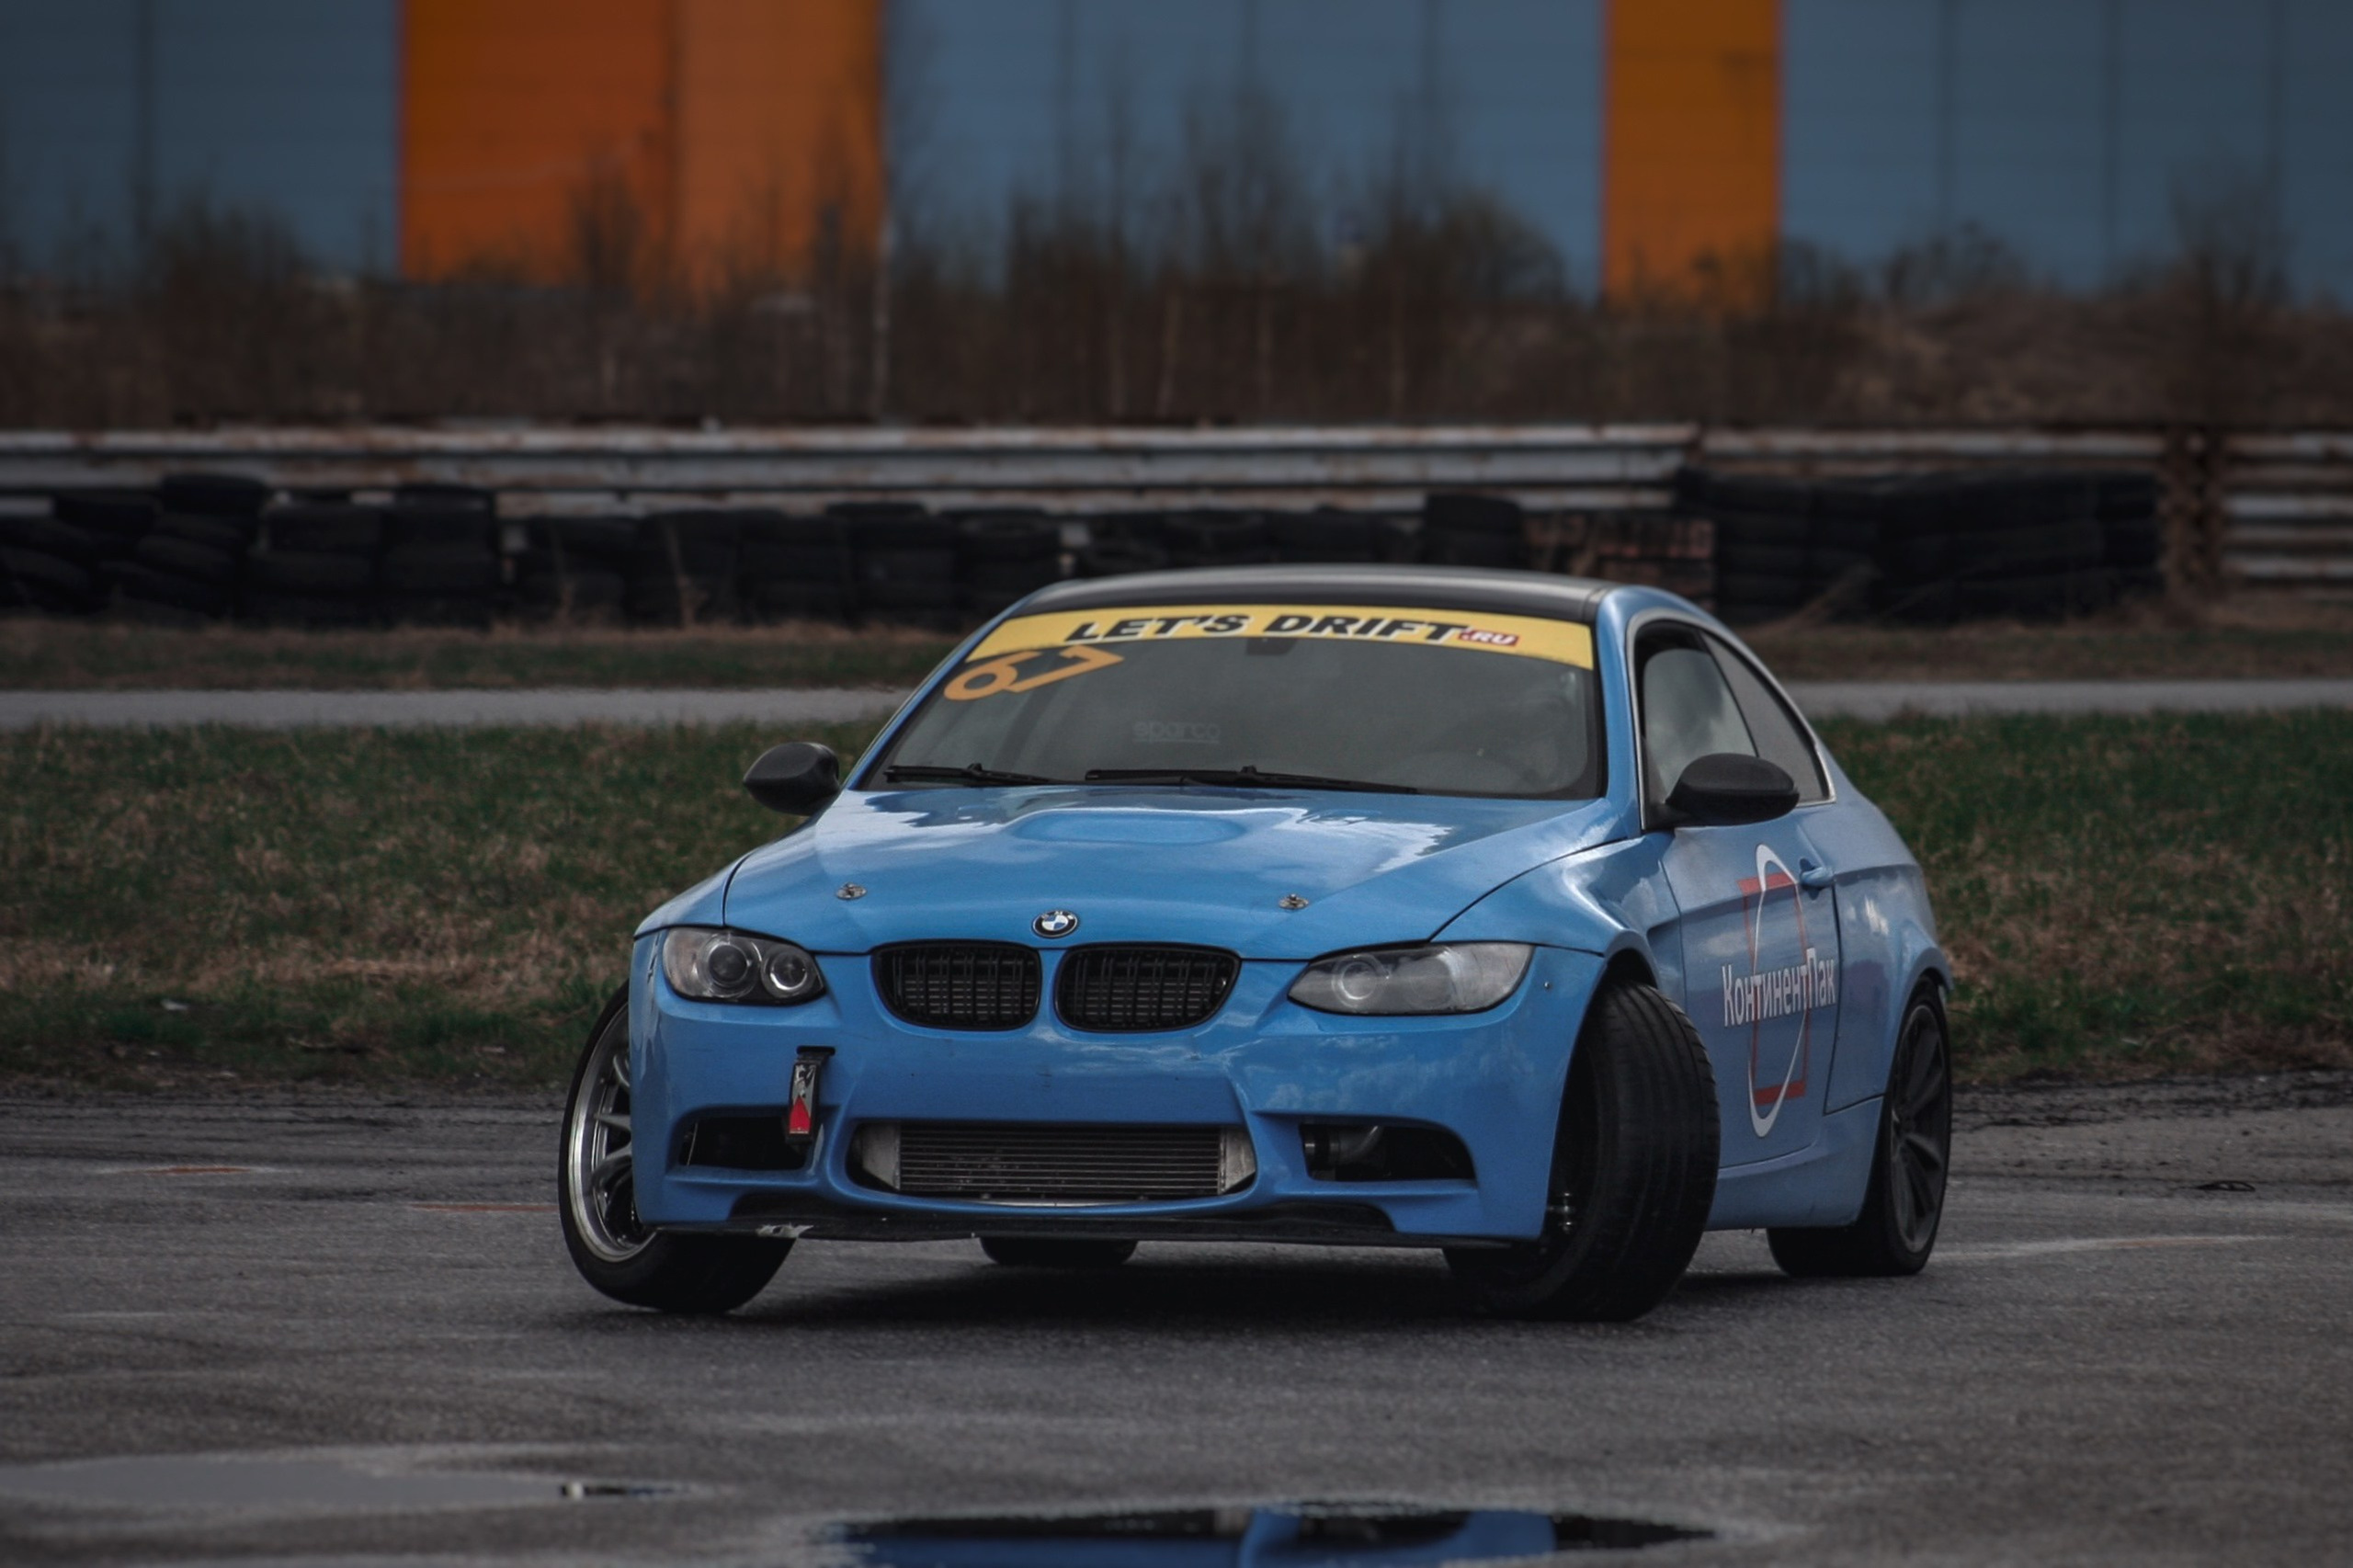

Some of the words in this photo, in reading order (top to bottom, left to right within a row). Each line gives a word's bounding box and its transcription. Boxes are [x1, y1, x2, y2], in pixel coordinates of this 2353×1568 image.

[1064, 615, 1255, 642] LET'S
[943, 644, 1125, 700] 67
[1722, 948, 1836, 1027] КонтинентПак
